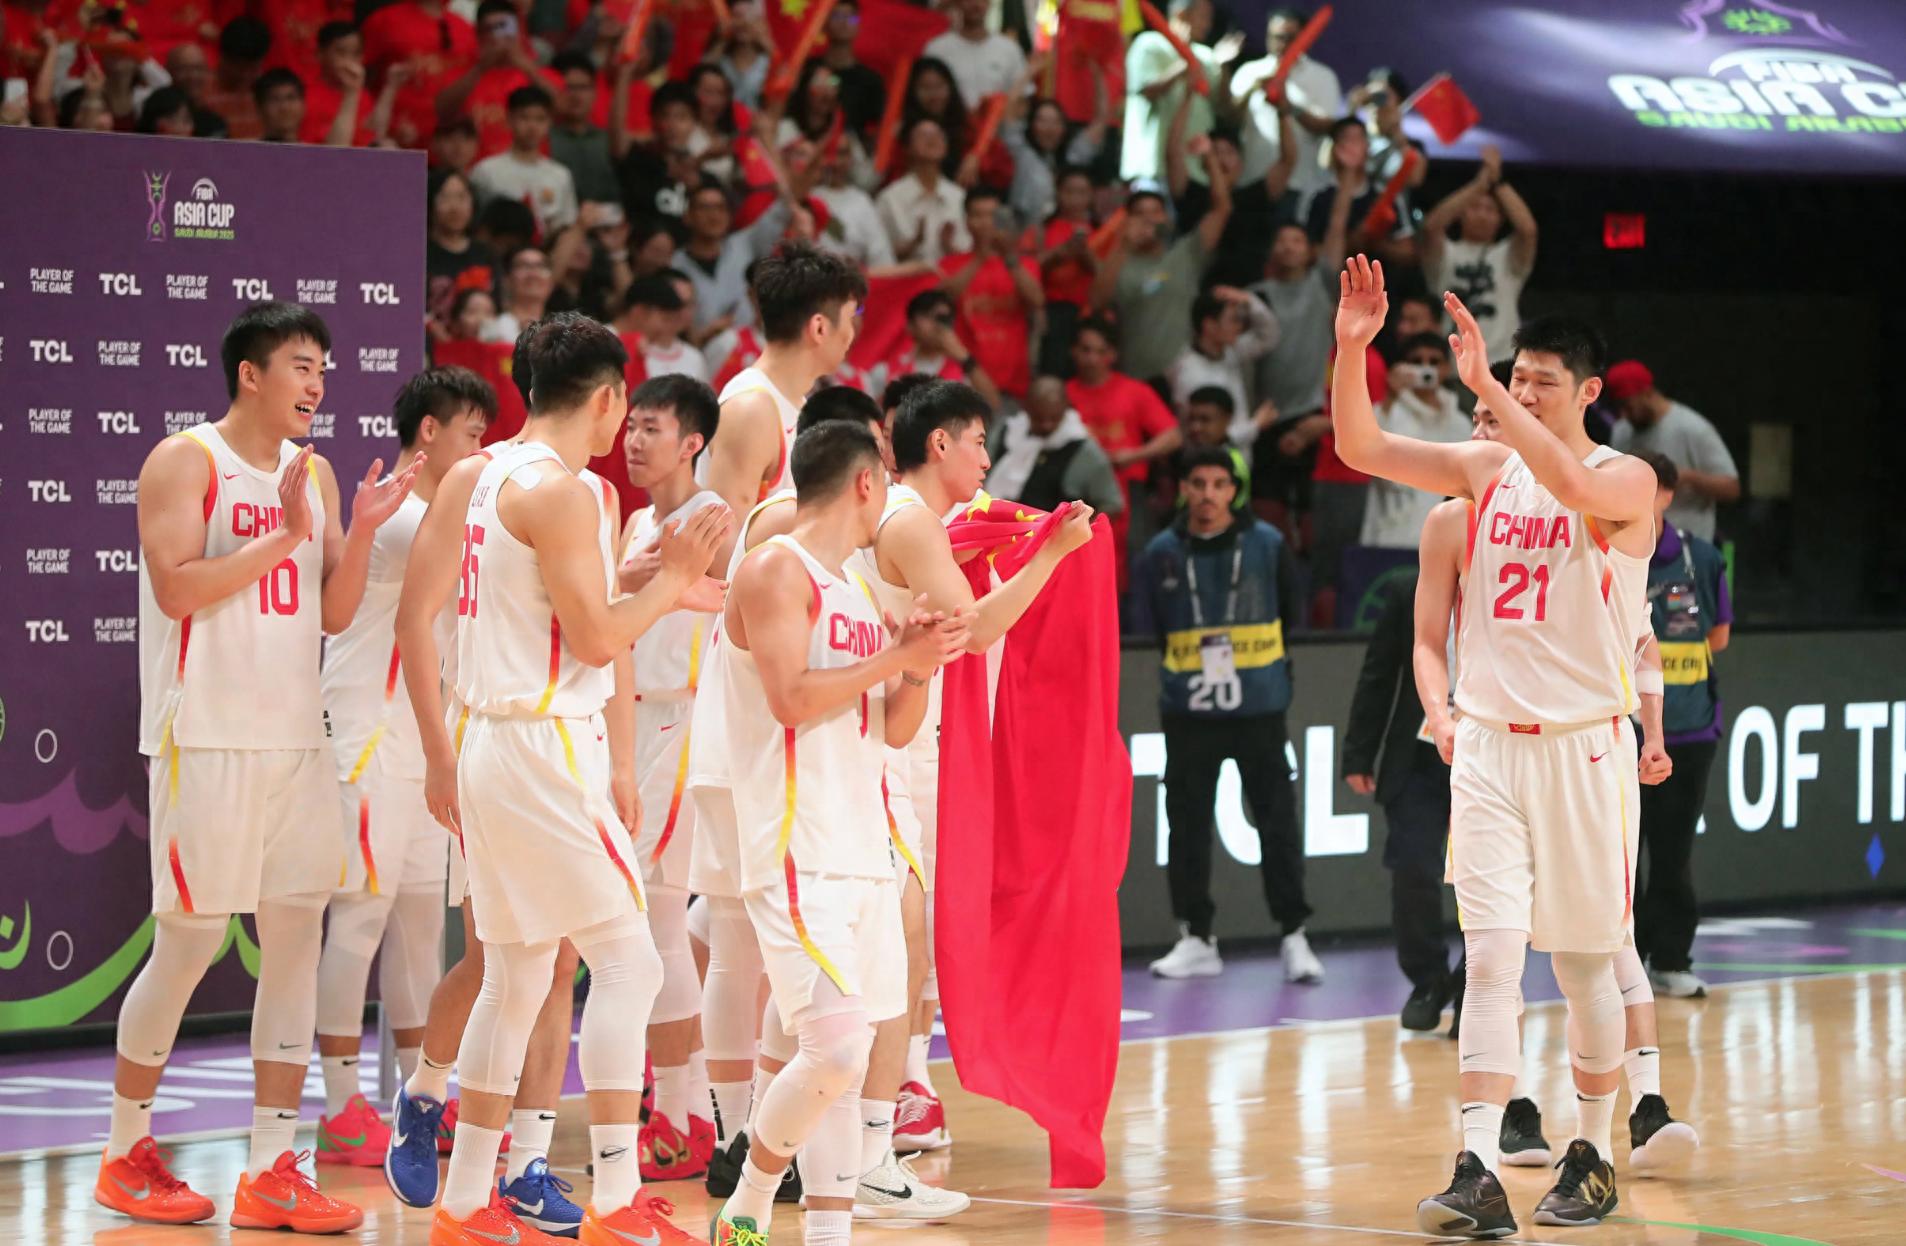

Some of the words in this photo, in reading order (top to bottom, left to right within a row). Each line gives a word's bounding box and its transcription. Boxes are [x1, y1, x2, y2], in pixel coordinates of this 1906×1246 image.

[1607, 74, 1836, 116] ASIA
[174, 201, 206, 227] ASIA
[207, 202, 235, 228] CUP
[30, 268, 61, 281] PLAYER
[62, 270, 74, 281] OF
[166, 274, 196, 287] PLAYER
[197, 275, 208, 287] OF
[31, 281, 49, 293] THE
[49, 281, 72, 294] GAME
[99, 273, 142, 296] TCL
[232, 278, 273, 301] TCL
[296, 279, 324, 291] PLAYER
[325, 280, 338, 292] OF
[167, 287, 184, 298] THE
[184, 287, 207, 300] GAME
[298, 291, 313, 303] THE
[314, 292, 336, 304] GAME
[360, 282, 400, 305] TCL
[29, 340, 73, 362] TCL
[98, 341, 128, 354] PLAYER
[129, 342, 141, 354] OF
[358, 348, 386, 360] PLAYER
[387, 348, 399, 360] OF
[99, 354, 116, 365] THE
[117, 354, 140, 366] GAME
[166, 344, 207, 367] TCL
[360, 360, 376, 371] THE
[376, 361, 398, 372] GAME
[28, 408, 60, 421] PLAYER
[60, 409, 72, 421] OF
[164, 411, 195, 424] PLAYER
[195, 412, 206, 424] OF
[30, 421, 48, 433] THE
[48, 422, 71, 434] GAME
[97, 412, 140, 434] TCL
[358, 416, 398, 438] TCL
[28, 480, 71, 502] TCL
[96, 479, 127, 492] PLAYER
[97, 492, 114, 504] THE
[114, 492, 138, 504] GAME
[1489, 511, 1571, 549] CHINA
[26, 548, 58, 561] PLAYER
[58, 548, 71, 561] OF
[95, 550, 138, 572] TCL
[27, 561, 44, 573] THE
[44, 561, 69, 574] GAME
[259, 558, 299, 616] 10
[1493, 562, 1549, 622] 21
[94, 617, 126, 630] PLAYER
[126, 617, 137, 630] OF
[25, 620, 69, 642] TCL
[95, 630, 112, 642] THE
[112, 630, 136, 642] GAME
[1187, 673, 1242, 711] 20
[1728, 705, 1826, 832] OF
